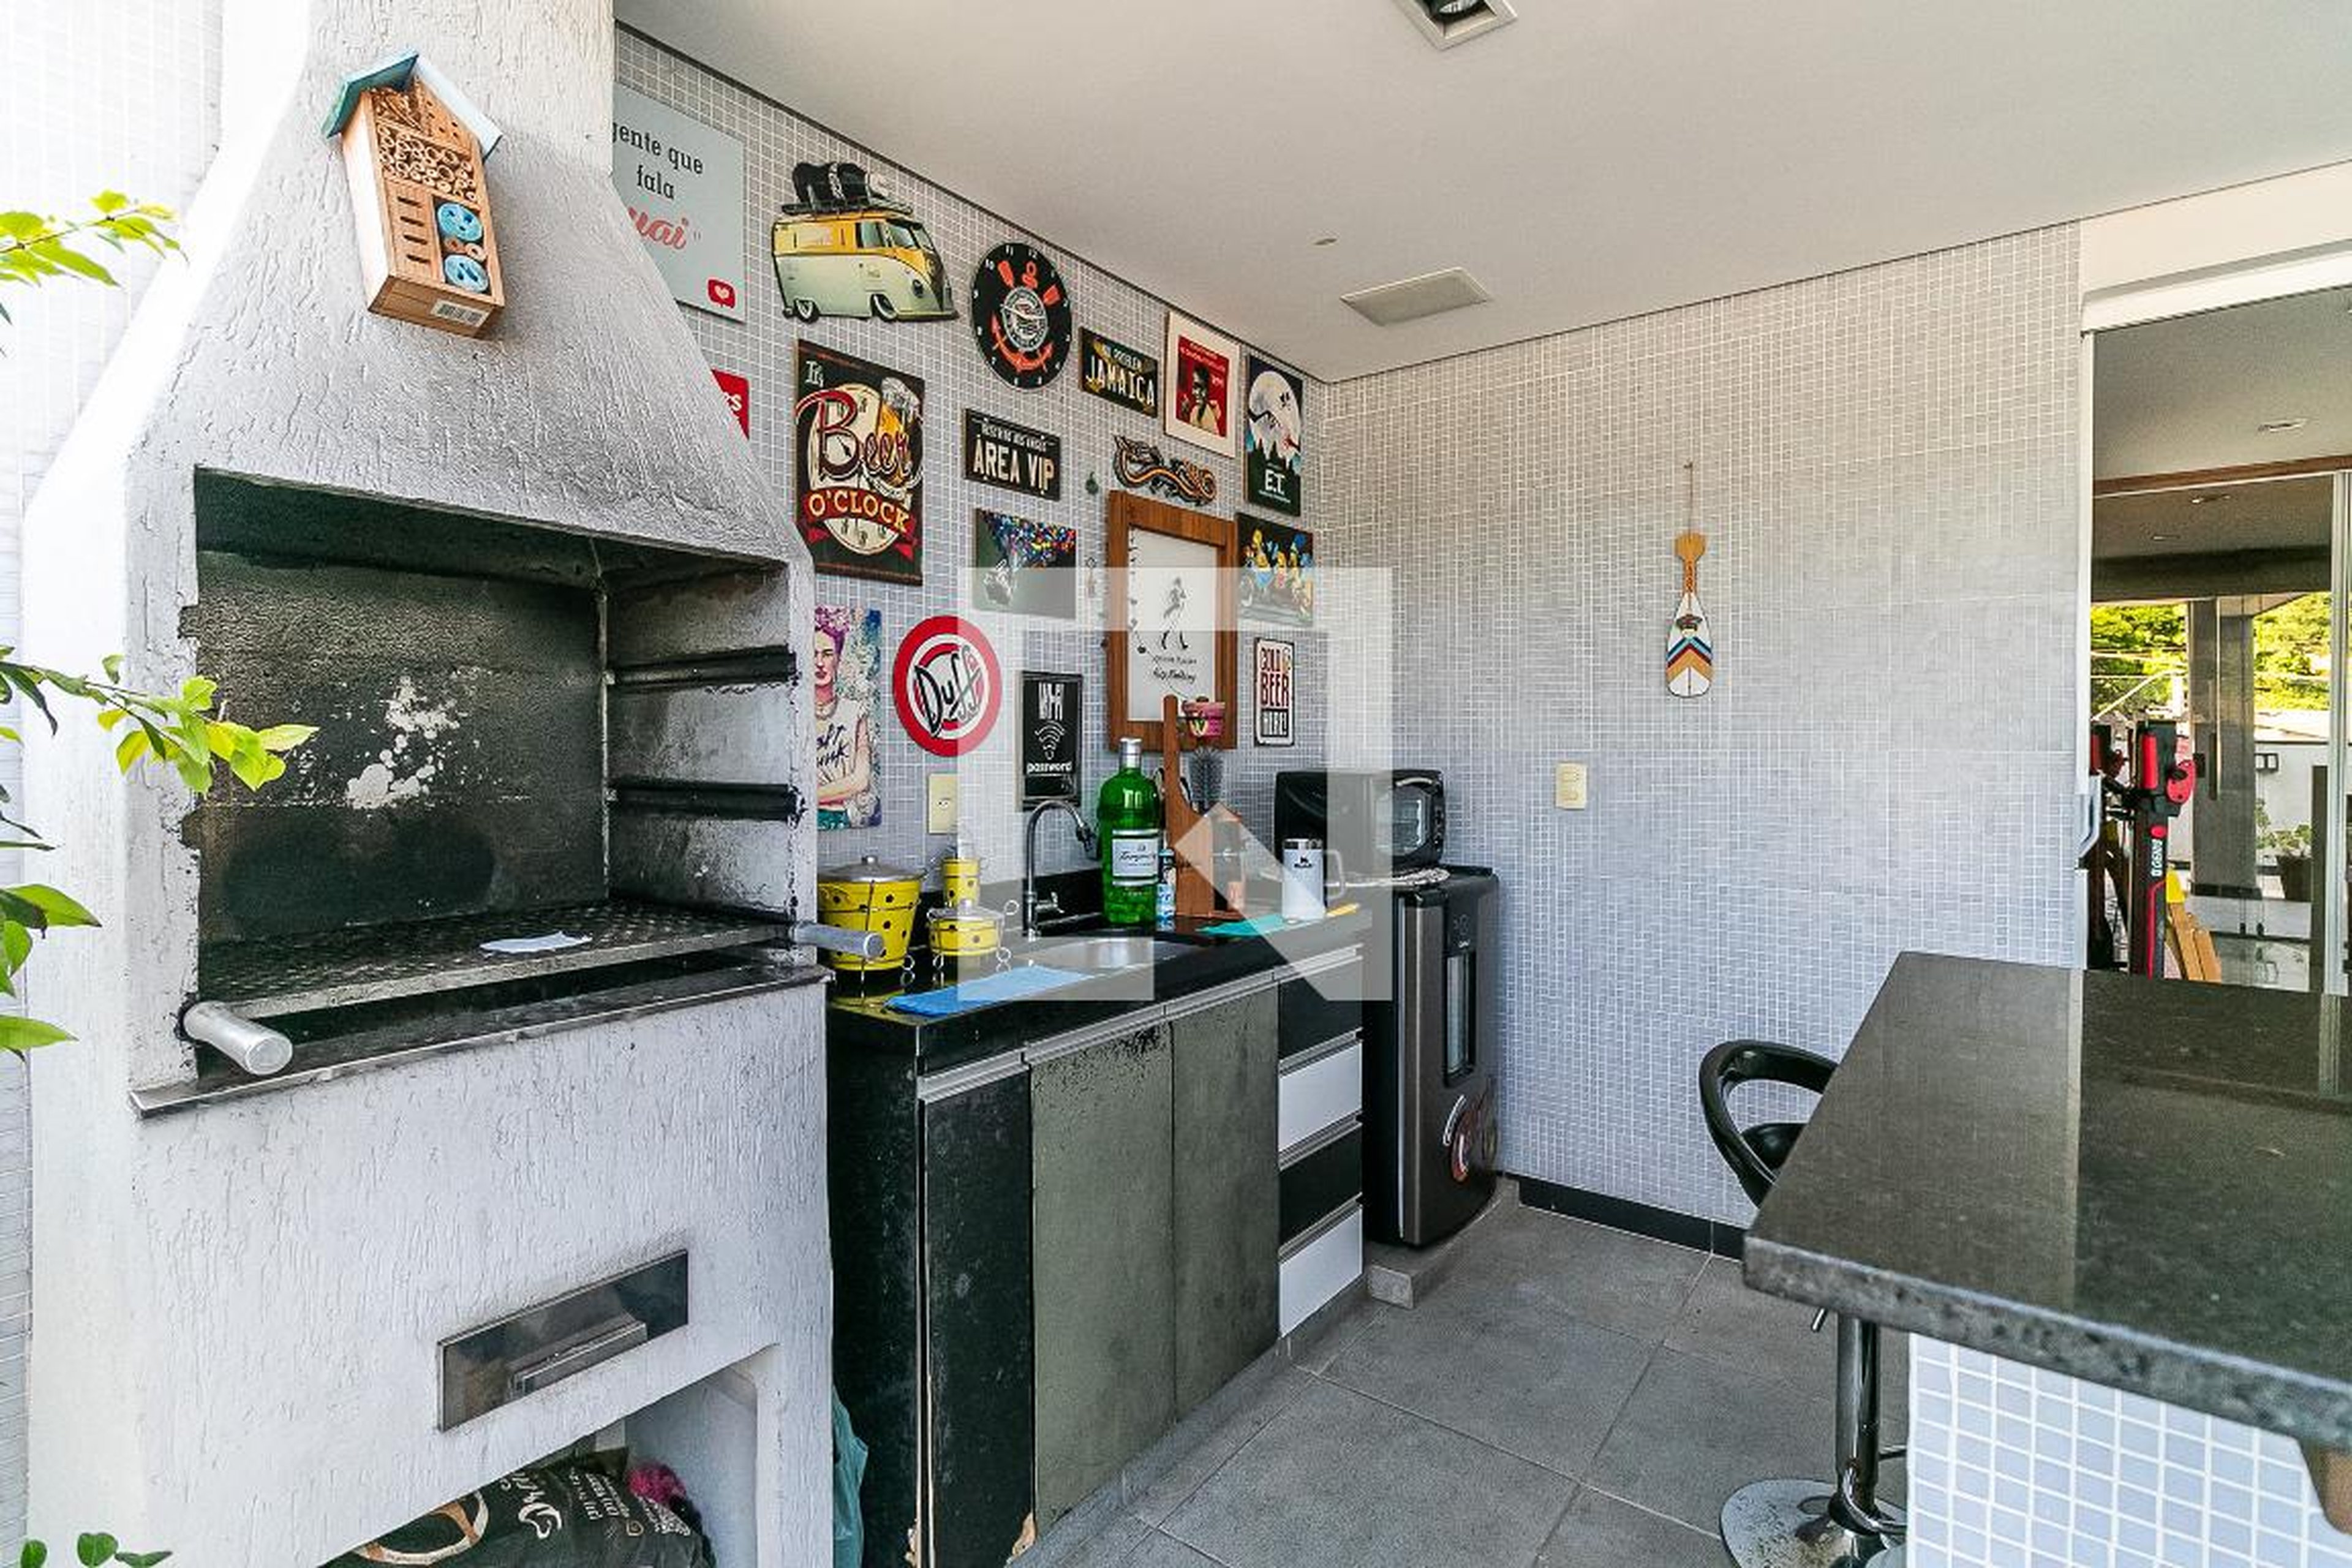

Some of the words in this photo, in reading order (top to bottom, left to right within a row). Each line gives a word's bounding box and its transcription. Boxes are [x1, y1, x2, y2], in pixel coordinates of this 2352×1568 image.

[668, 147, 704, 175] que
[637, 165, 674, 199] fala
[1085, 355, 1155, 406] JAMAICA
[794, 389, 912, 481] Beer
[1027, 452, 1055, 491] VIP
[808, 490, 910, 533] O'CLOCK
[914, 645, 982, 736] Duff
[1261, 672, 1289, 706] BEER
[1026, 761, 1072, 774] password
